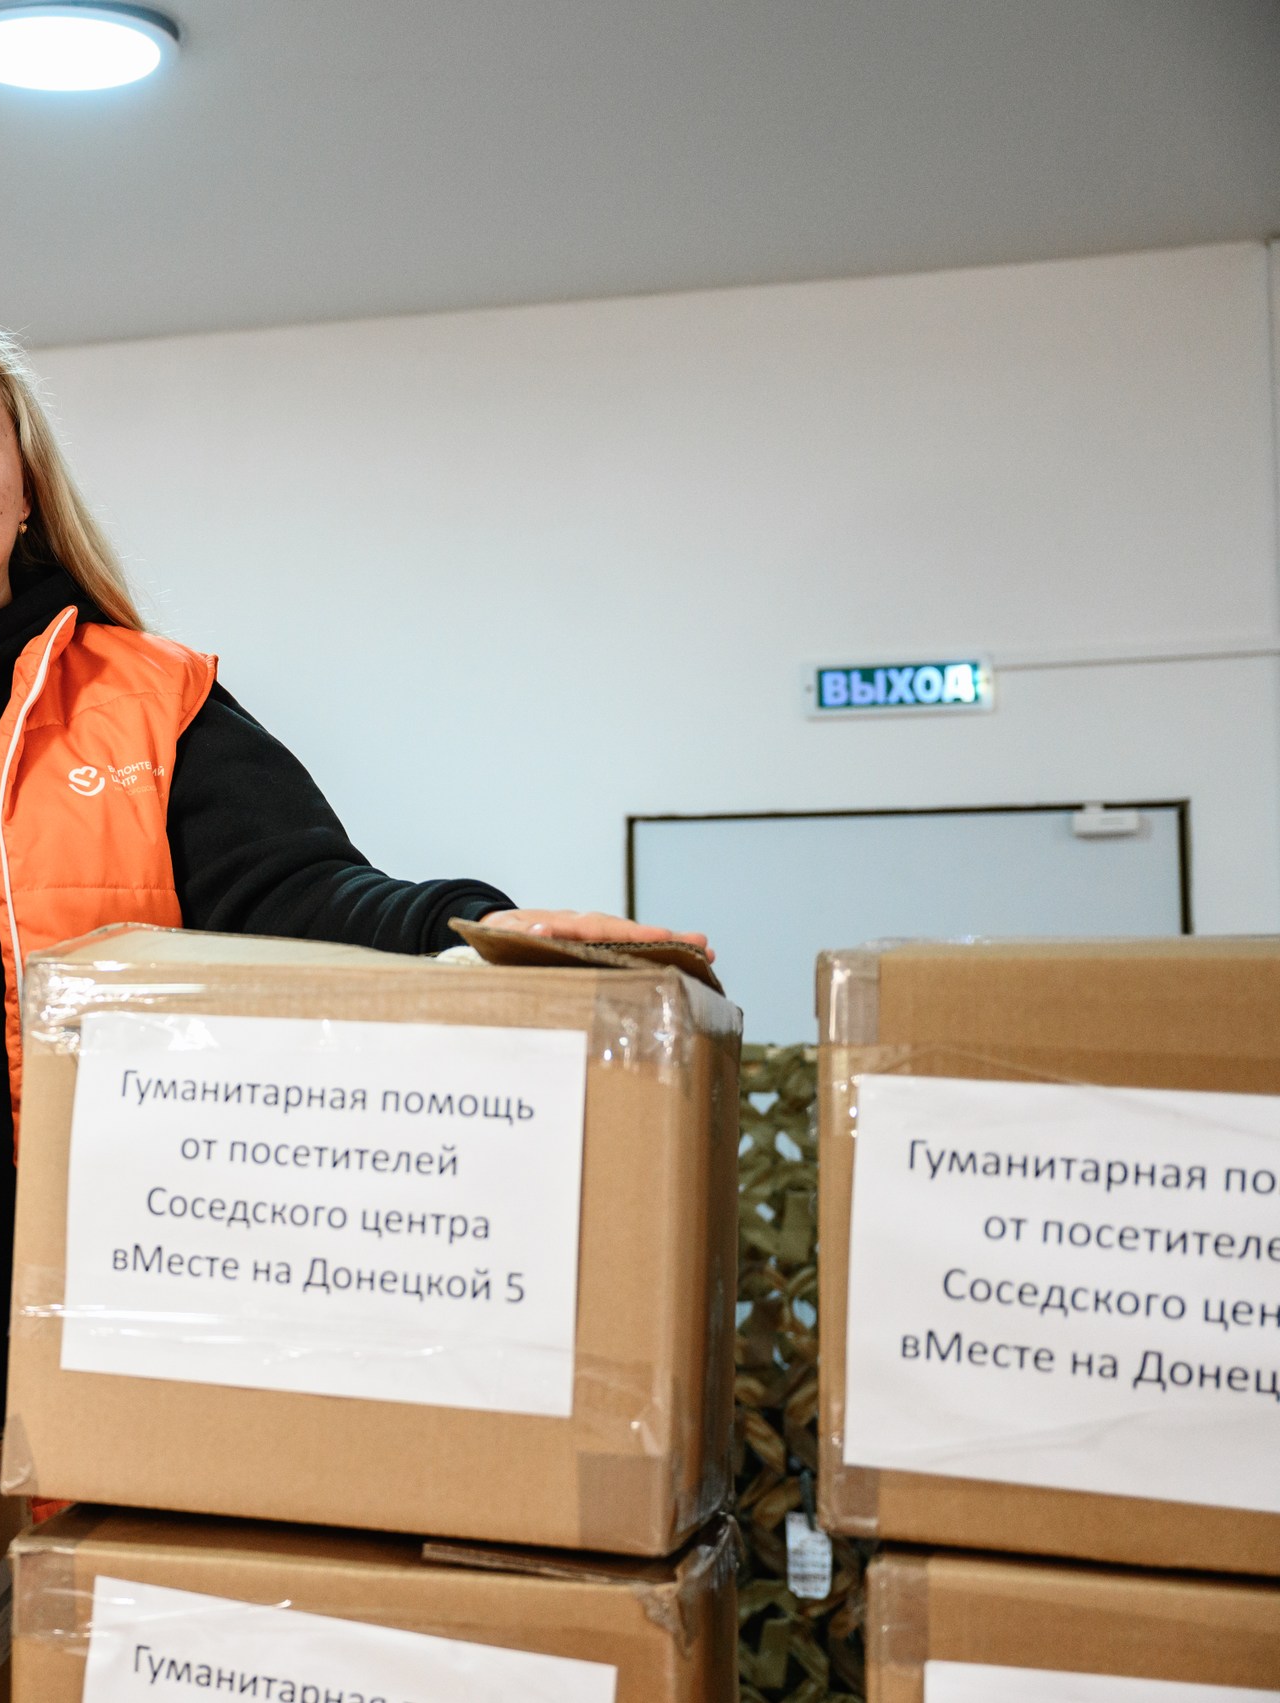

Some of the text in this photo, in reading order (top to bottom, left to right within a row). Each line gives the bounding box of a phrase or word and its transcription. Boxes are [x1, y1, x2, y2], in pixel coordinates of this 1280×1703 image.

[821, 664, 975, 706] ВЫХОД
[121, 1069, 535, 1126] Гуманитарная помощь
[180, 1138, 458, 1176] от посетителей
[909, 1139, 1207, 1193] Гуманитарная
[146, 1186, 490, 1245] Соседского центра
[983, 1216, 1027, 1241] от
[112, 1243, 525, 1304] вМесте на Донецкой 5
[942, 1268, 1187, 1320] Соседского
[901, 1329, 1280, 1403] вМесте на Донец
